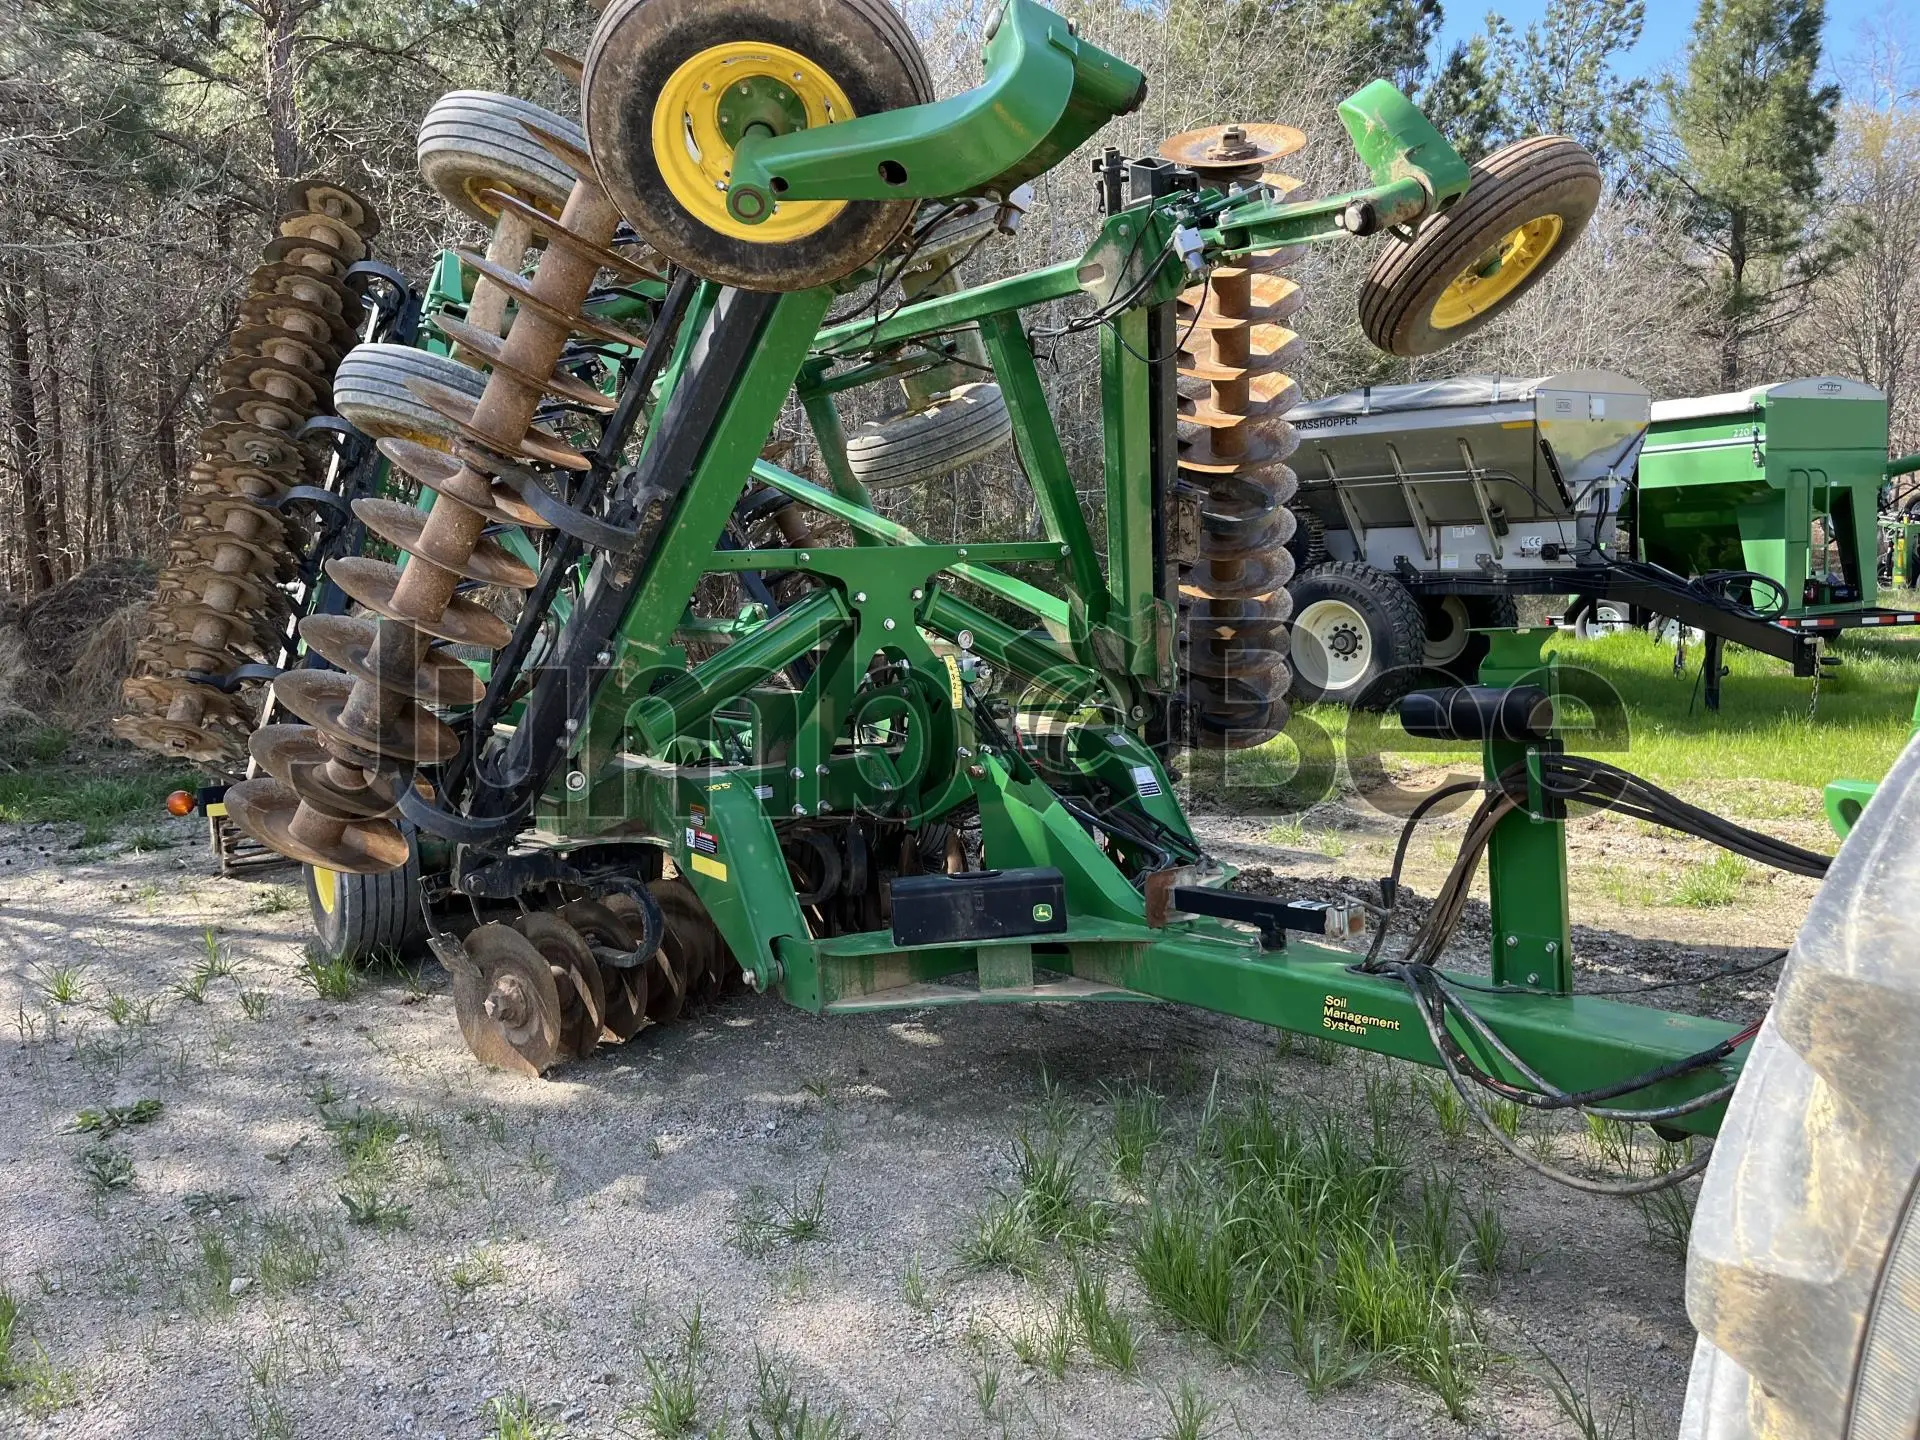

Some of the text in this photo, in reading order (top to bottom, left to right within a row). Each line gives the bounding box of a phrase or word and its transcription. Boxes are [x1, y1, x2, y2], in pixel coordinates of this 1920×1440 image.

[1294, 416, 1358, 431] RASSHOPPER
[952, 682, 957, 690] 2
[1324, 995, 1347, 1009] Soil
[1323, 1006, 1401, 1030] Management
[1322, 1017, 1367, 1036] System
